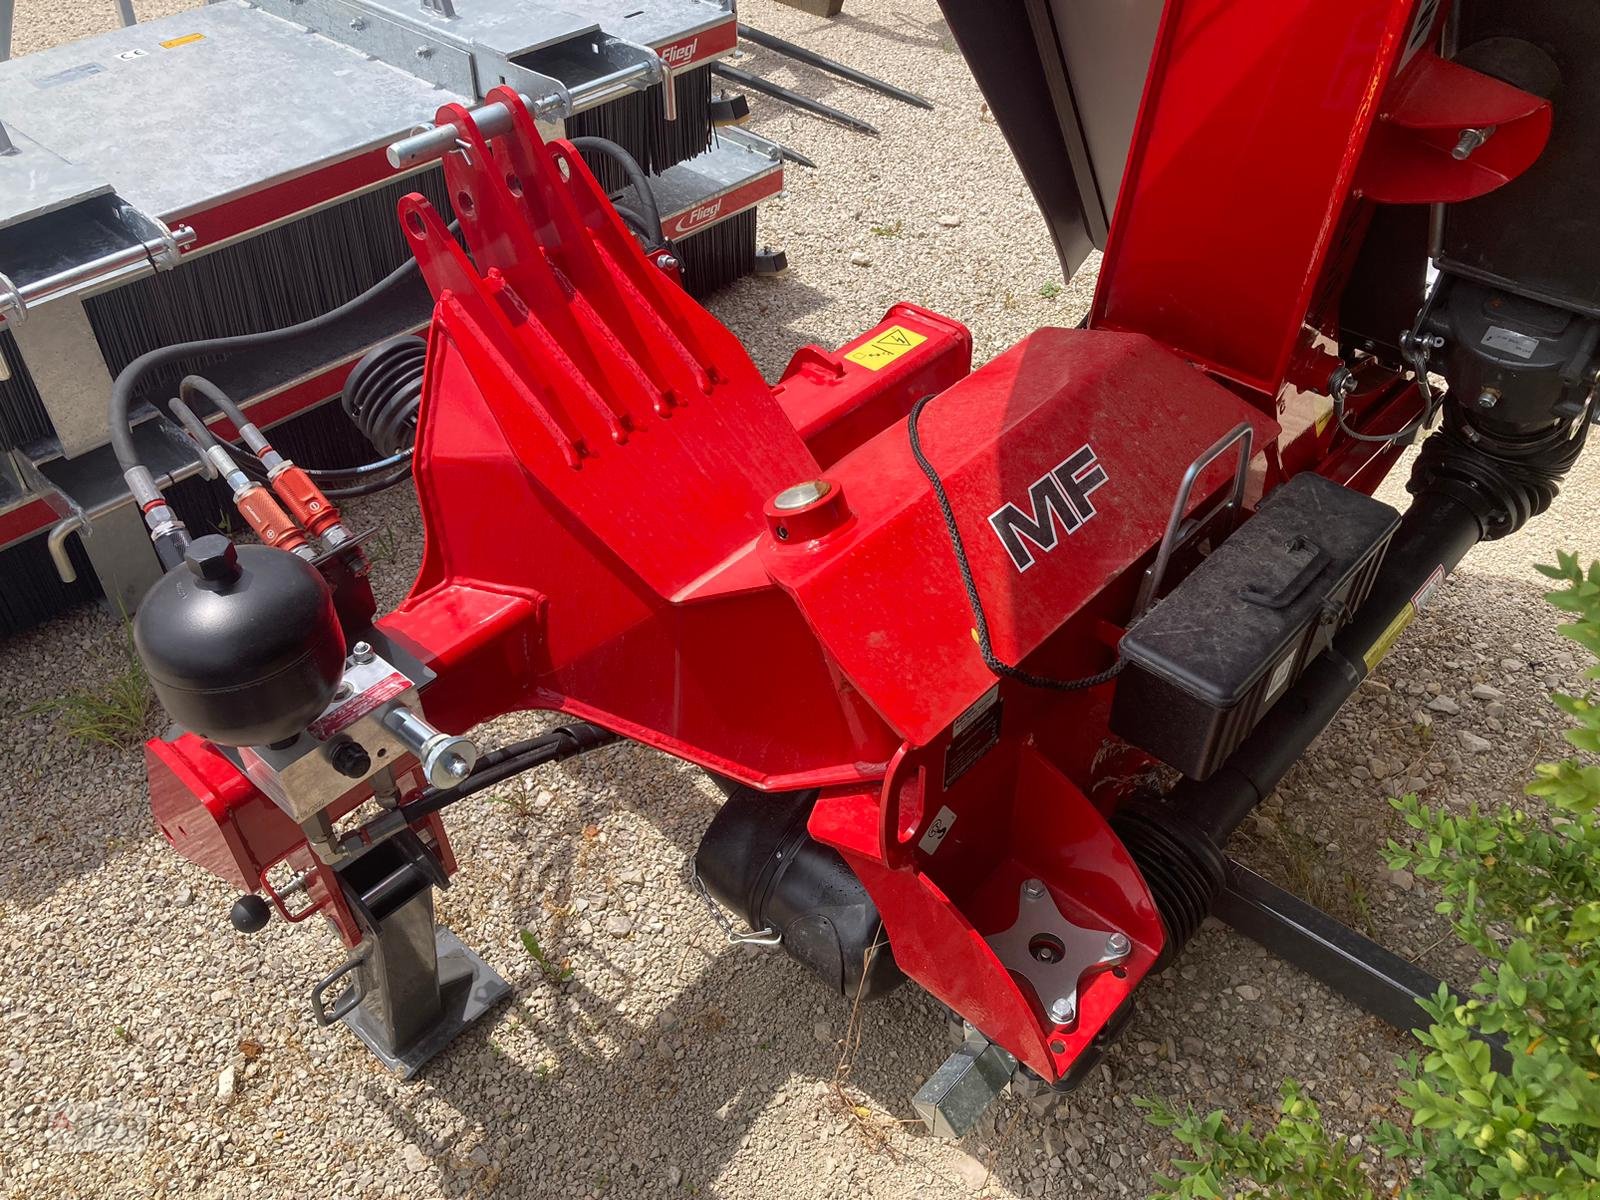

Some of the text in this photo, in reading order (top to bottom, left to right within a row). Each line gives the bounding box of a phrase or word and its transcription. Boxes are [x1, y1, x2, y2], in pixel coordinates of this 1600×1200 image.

[661, 38, 698, 62] Fliegl
[689, 198, 722, 224] Fliegl
[987, 443, 1109, 573] MF
